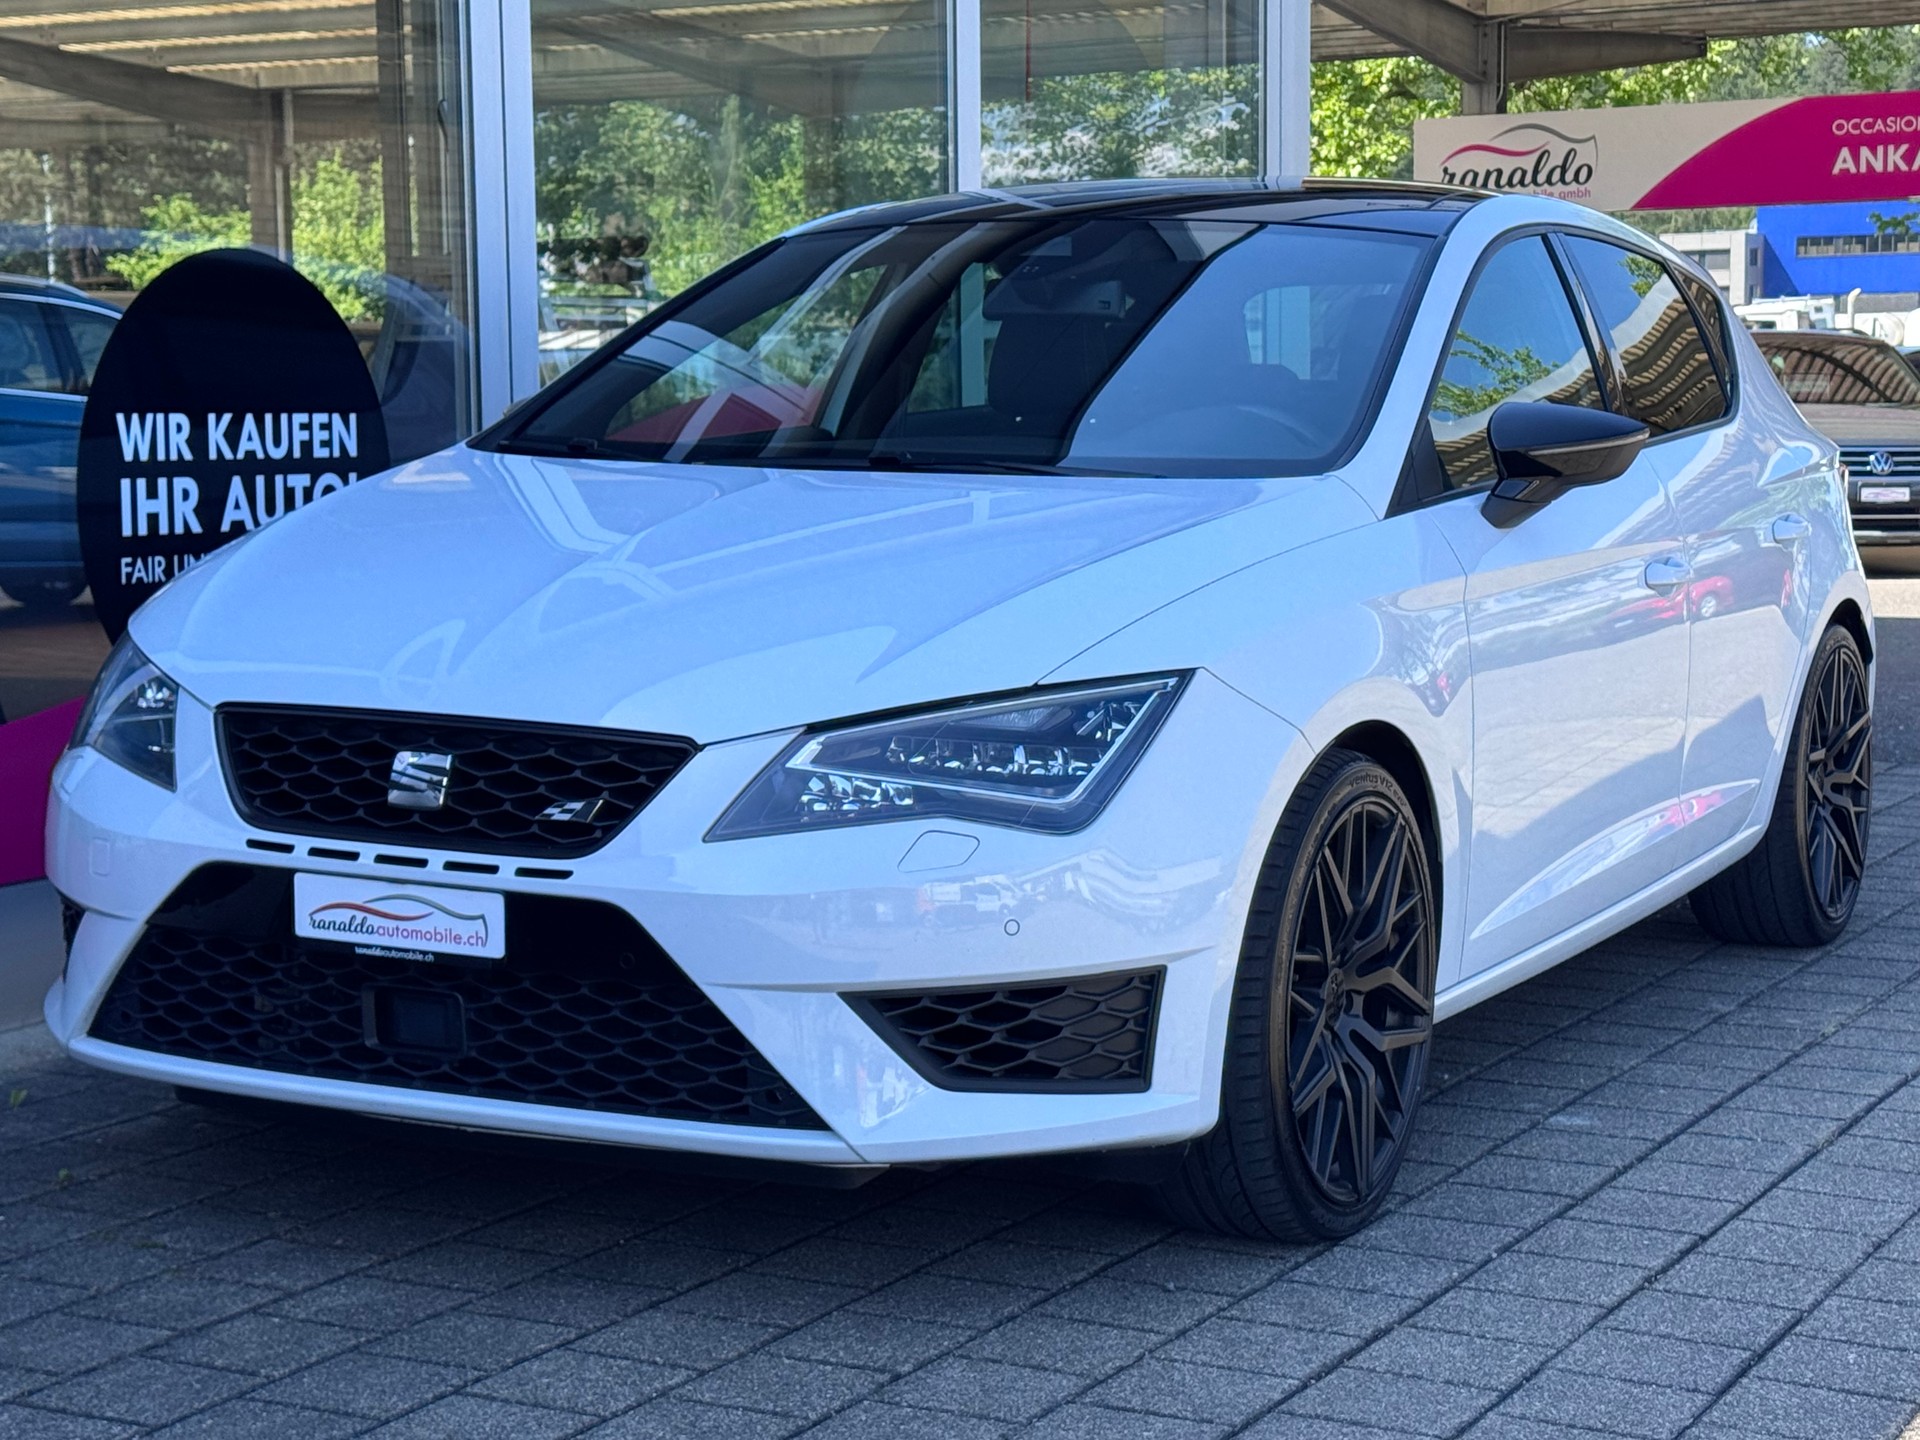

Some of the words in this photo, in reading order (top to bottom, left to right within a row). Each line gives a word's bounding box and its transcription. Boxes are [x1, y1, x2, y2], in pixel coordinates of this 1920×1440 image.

[1831, 115, 1920, 136] OCCASIO
[1441, 147, 1594, 189] ranaldo
[1558, 186, 1592, 200] gmbh
[116, 412, 194, 462] WIR
[207, 412, 358, 461] KAUFEN
[120, 476, 203, 537] IHR
[120, 555, 167, 585] FAIR
[309, 914, 485, 948] ranaldoautomobile.ch
